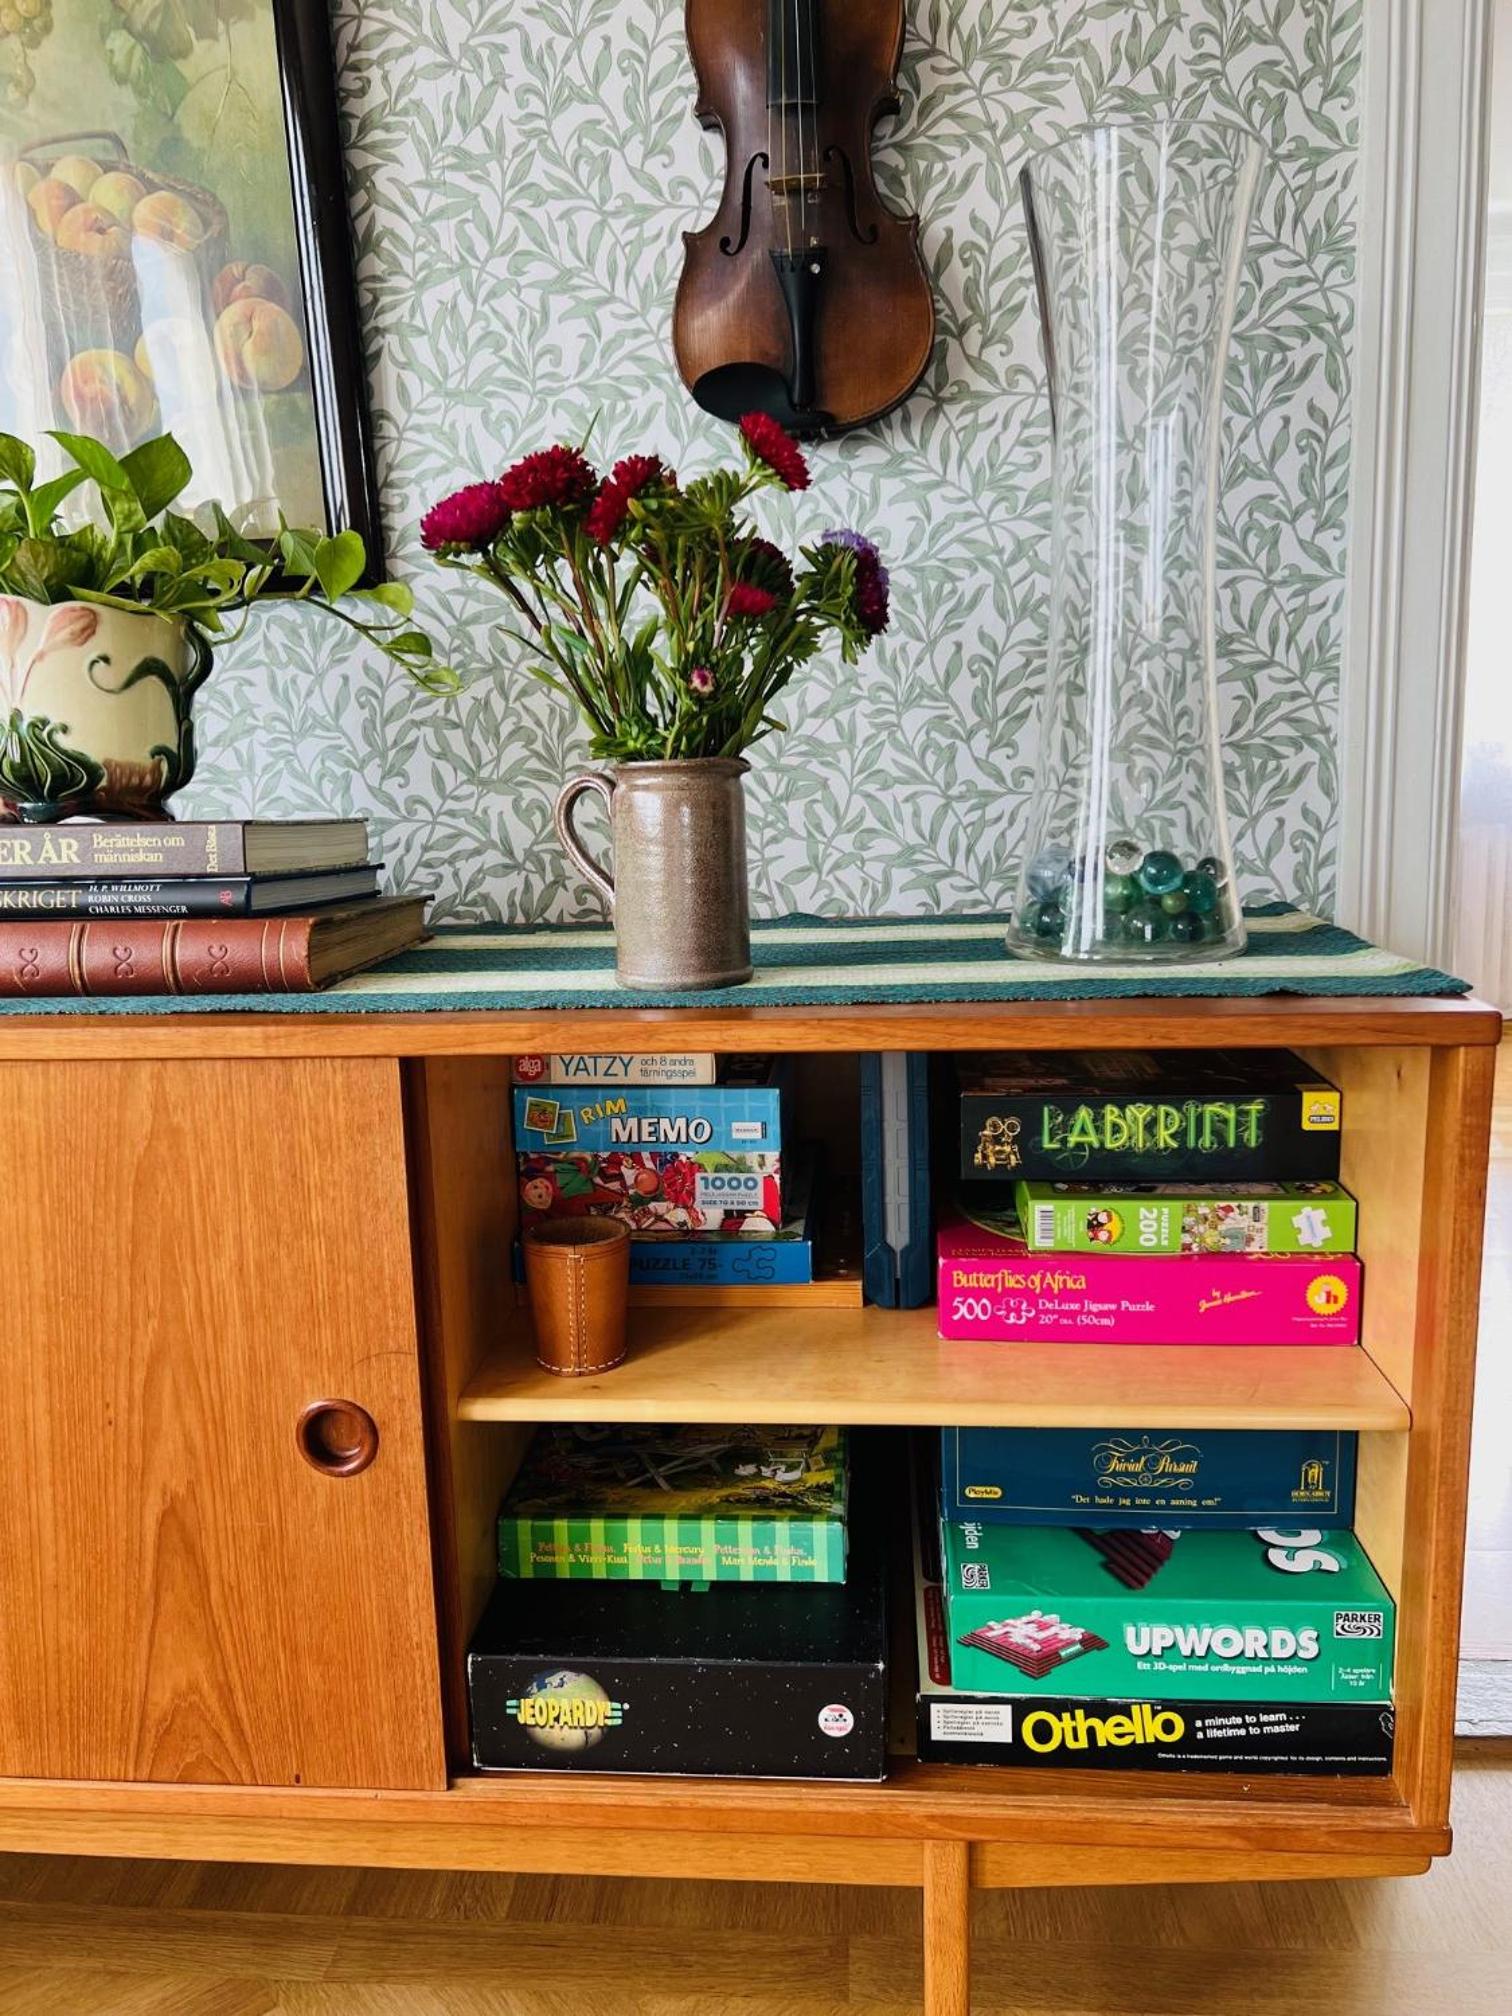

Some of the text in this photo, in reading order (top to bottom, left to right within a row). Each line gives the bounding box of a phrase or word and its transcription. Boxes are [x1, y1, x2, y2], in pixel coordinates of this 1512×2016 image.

[38, 832, 81, 864] ÅR
[92, 832, 185, 848] Berättelsen om
[94, 849, 163, 863] människan
[111, 884, 161, 892] WILLMOTT
[0, 889, 82, 909] KRIGET
[88, 894, 152, 903] ROBIN CROSS
[88, 905, 188, 914] CHARLES MESSENGER
[518, 1058, 541, 1076] alga
[559, 1056, 634, 1077] YATZY
[640, 1057, 658, 1066] och
[669, 1057, 695, 1066] andra
[579, 1097, 628, 1125] RIM
[611, 1117, 712, 1145] MEMO
[1043, 1101, 1265, 1149] LABYRINT
[700, 1176, 758, 1190] 1000
[1139, 1207, 1158, 1247] 200
[952, 1270, 1087, 1294] Butterflies of Africa
[952, 1298, 991, 1320] 500
[1039, 1300, 1155, 1313] DeLuxe Jigsaw Puzzle
[1077, 1315, 1115, 1326] (50cm)
[1145, 1454, 1199, 1475] Pursuit
[1095, 1495, 1114, 1505] hade
[1119, 1497, 1131, 1507] jag
[1135, 1496, 1150, 1505] inte
[1336, 1612, 1381, 1623] PARKER
[1123, 1625, 1320, 1660] UPWORDS
[1137, 1661, 1308, 1676] Ett 3D-spel med ordbyggnad på höjden
[1021, 1704, 1185, 1752] Othello
[1205, 1716, 1243, 1727] minute
[1245, 1714, 1257, 1723] to
[1196, 1723, 1300, 1739] a lifetime to master
